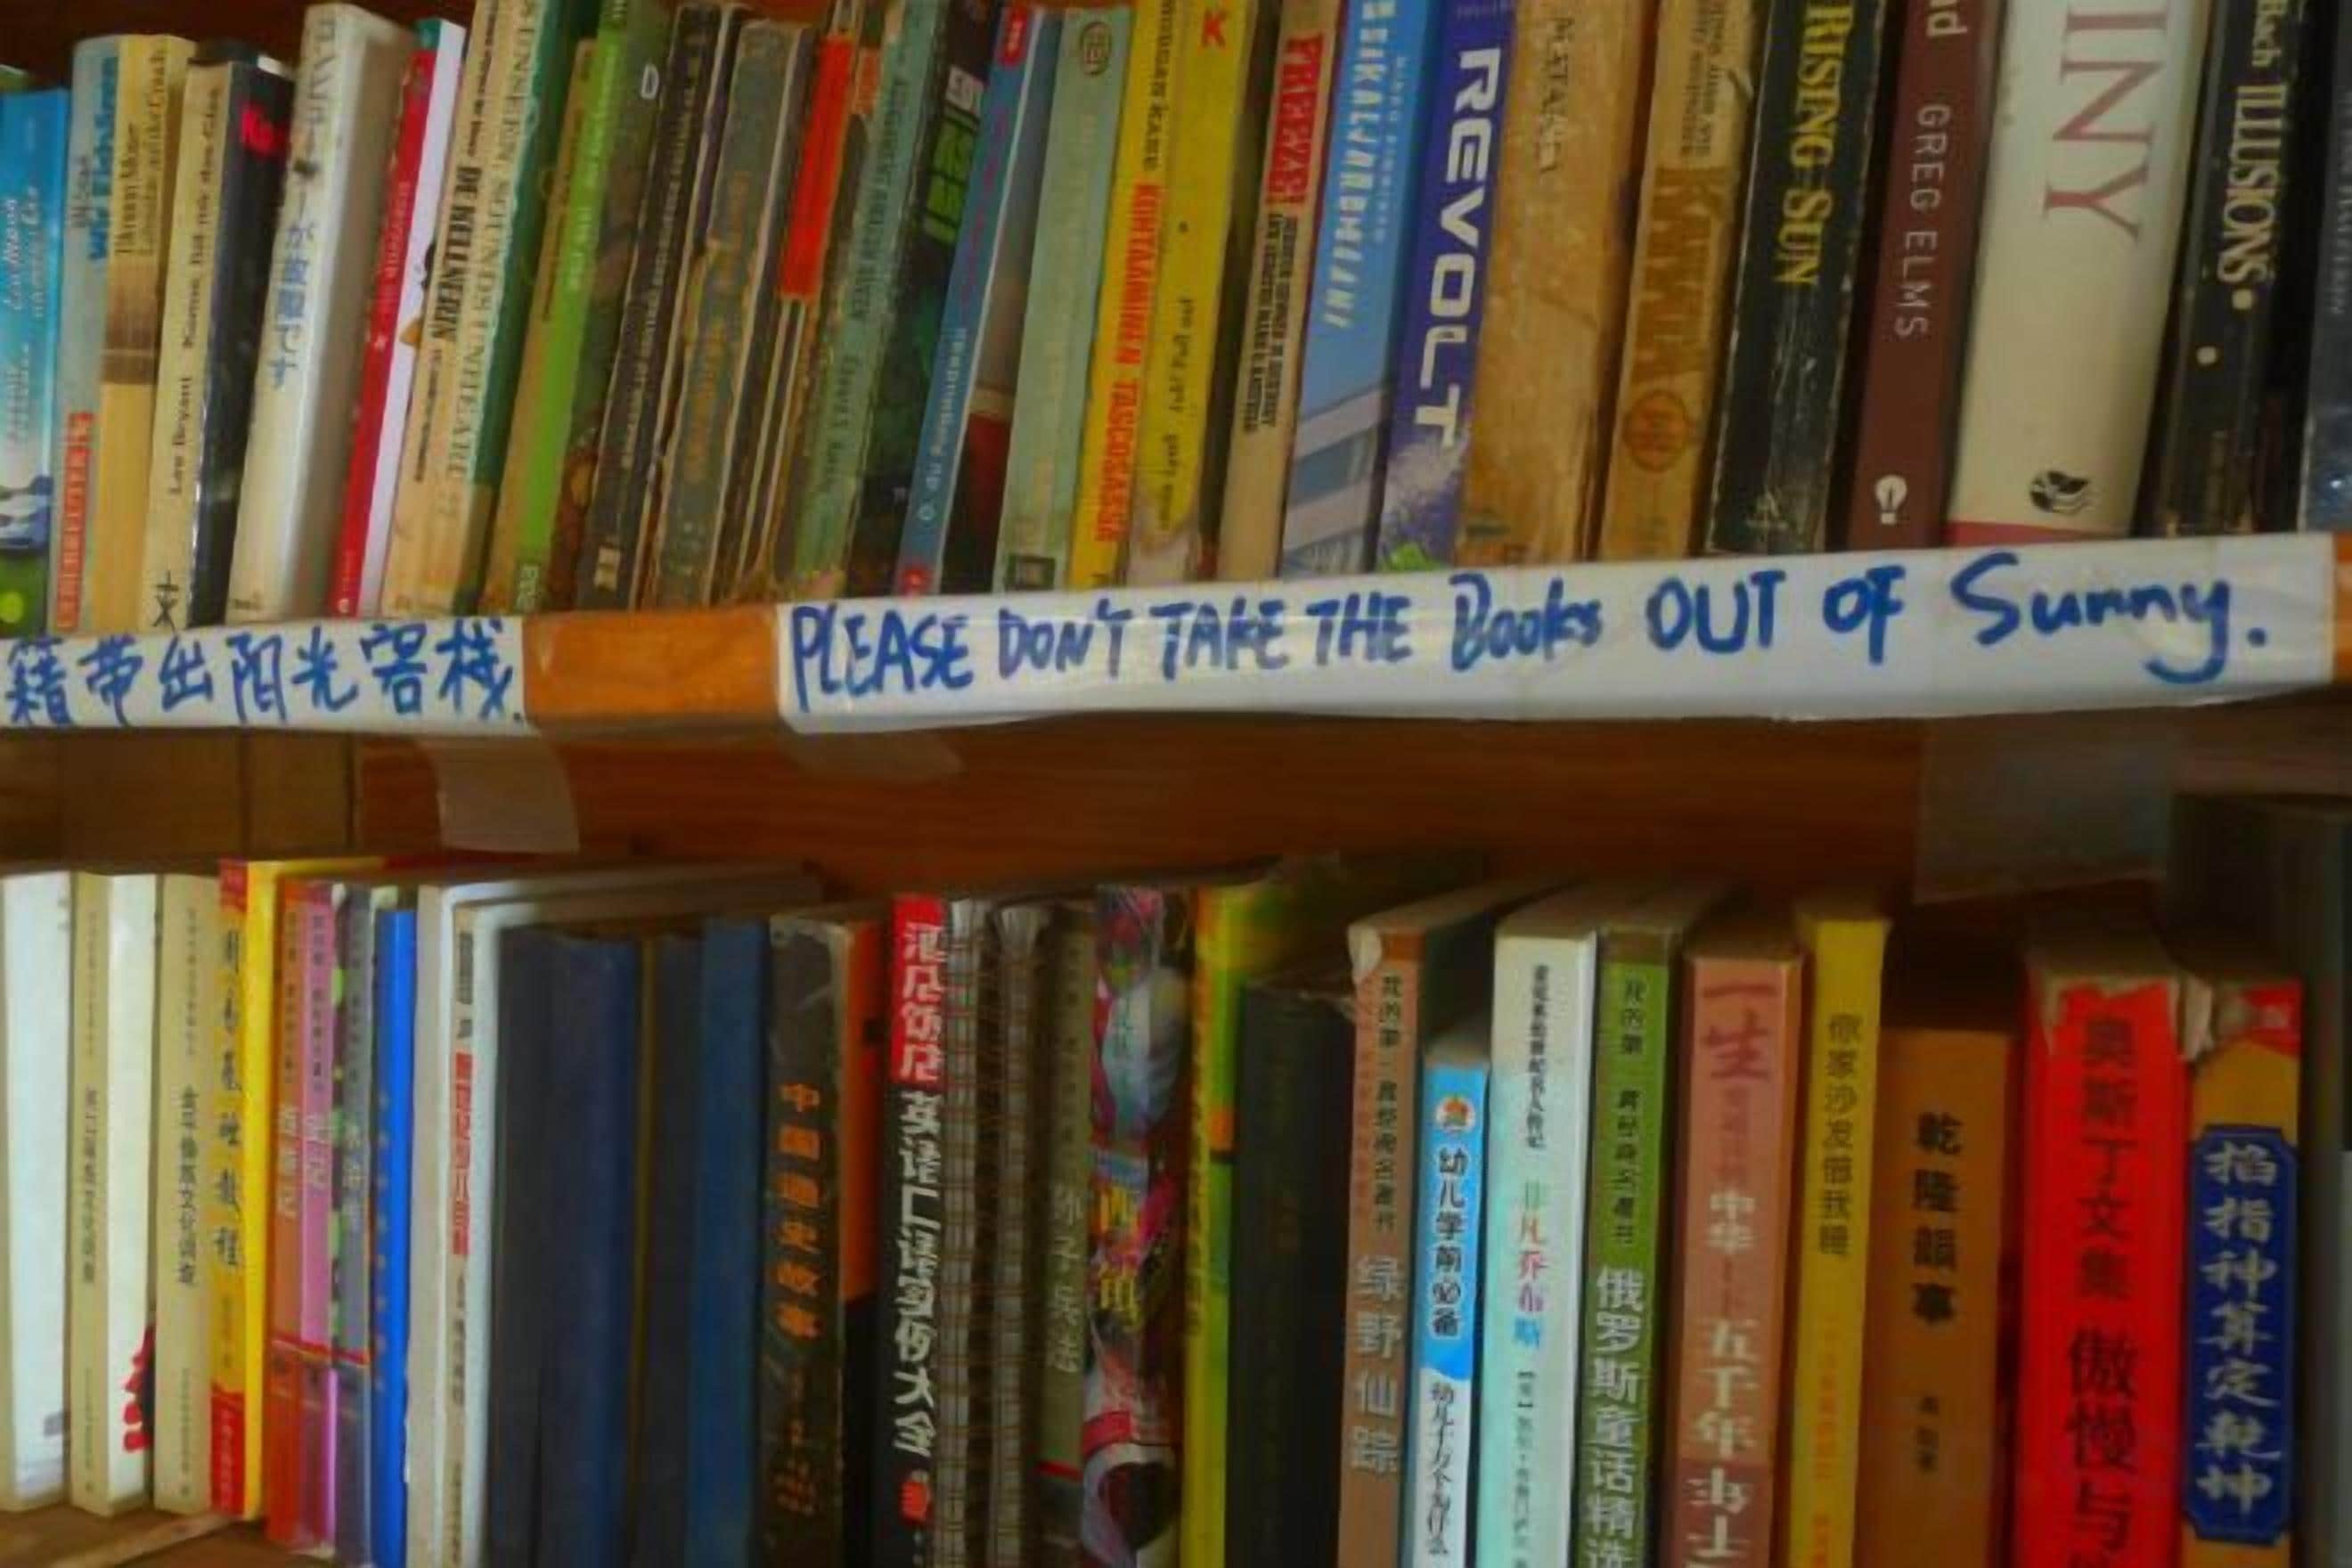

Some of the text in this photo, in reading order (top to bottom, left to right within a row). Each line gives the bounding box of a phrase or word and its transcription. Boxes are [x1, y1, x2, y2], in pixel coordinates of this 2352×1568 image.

[1416, 47, 1501, 448] REVOLT
[1773, 0, 1852, 287] RISING SUN
[1894, 102, 1953, 339] GREG ELMS
[2217, 82, 2288, 287] ILLUSIONS
[789, 605, 974, 714] PLEASE
[1149, 592, 1308, 680] TAKE
[1304, 590, 1413, 665] THE
[1450, 572, 1603, 671] Books
[1646, 568, 1786, 655] OUT
[1430, 1146, 1472, 1339] 幼儿学前必备
[1349, 1254, 1407, 1475] 绿野仙踪
